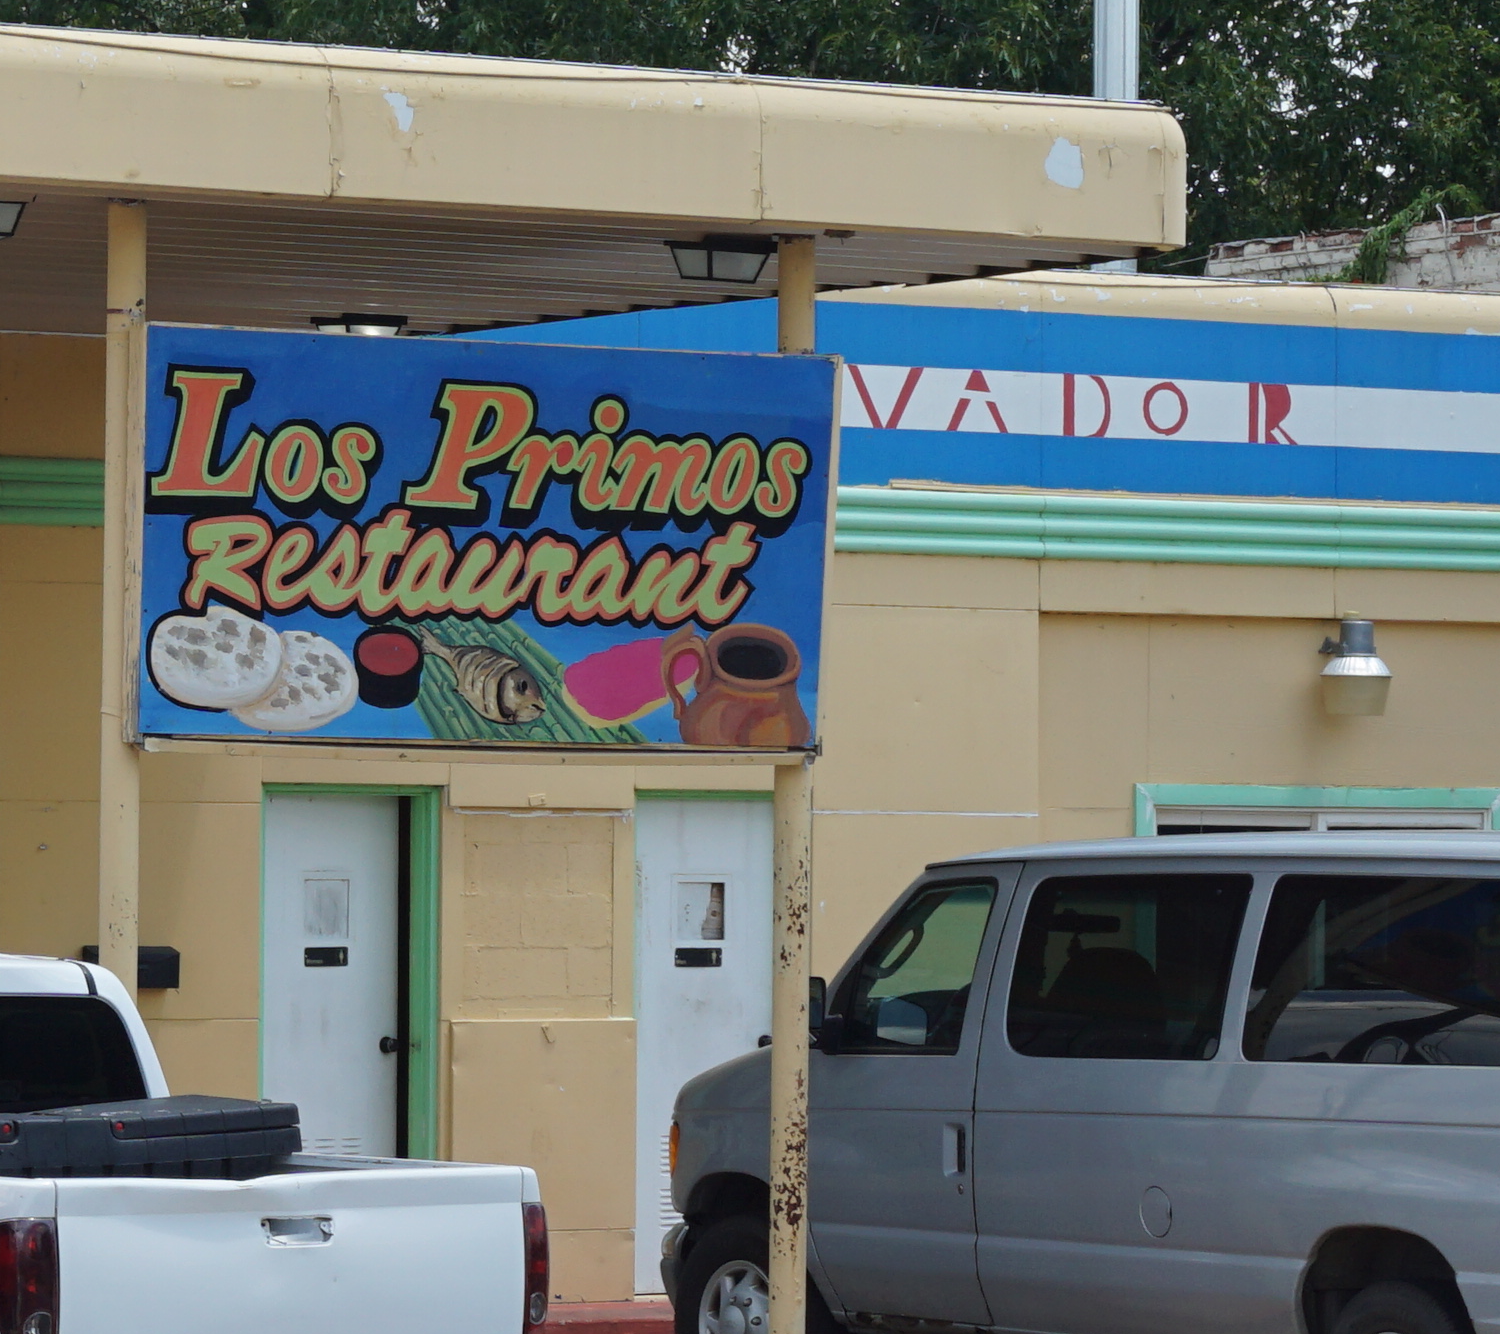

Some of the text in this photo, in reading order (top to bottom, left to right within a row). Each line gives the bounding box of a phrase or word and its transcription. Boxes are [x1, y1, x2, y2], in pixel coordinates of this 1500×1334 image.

[148, 366, 811, 527] Los Primos
[183, 508, 760, 627] Restaurant
